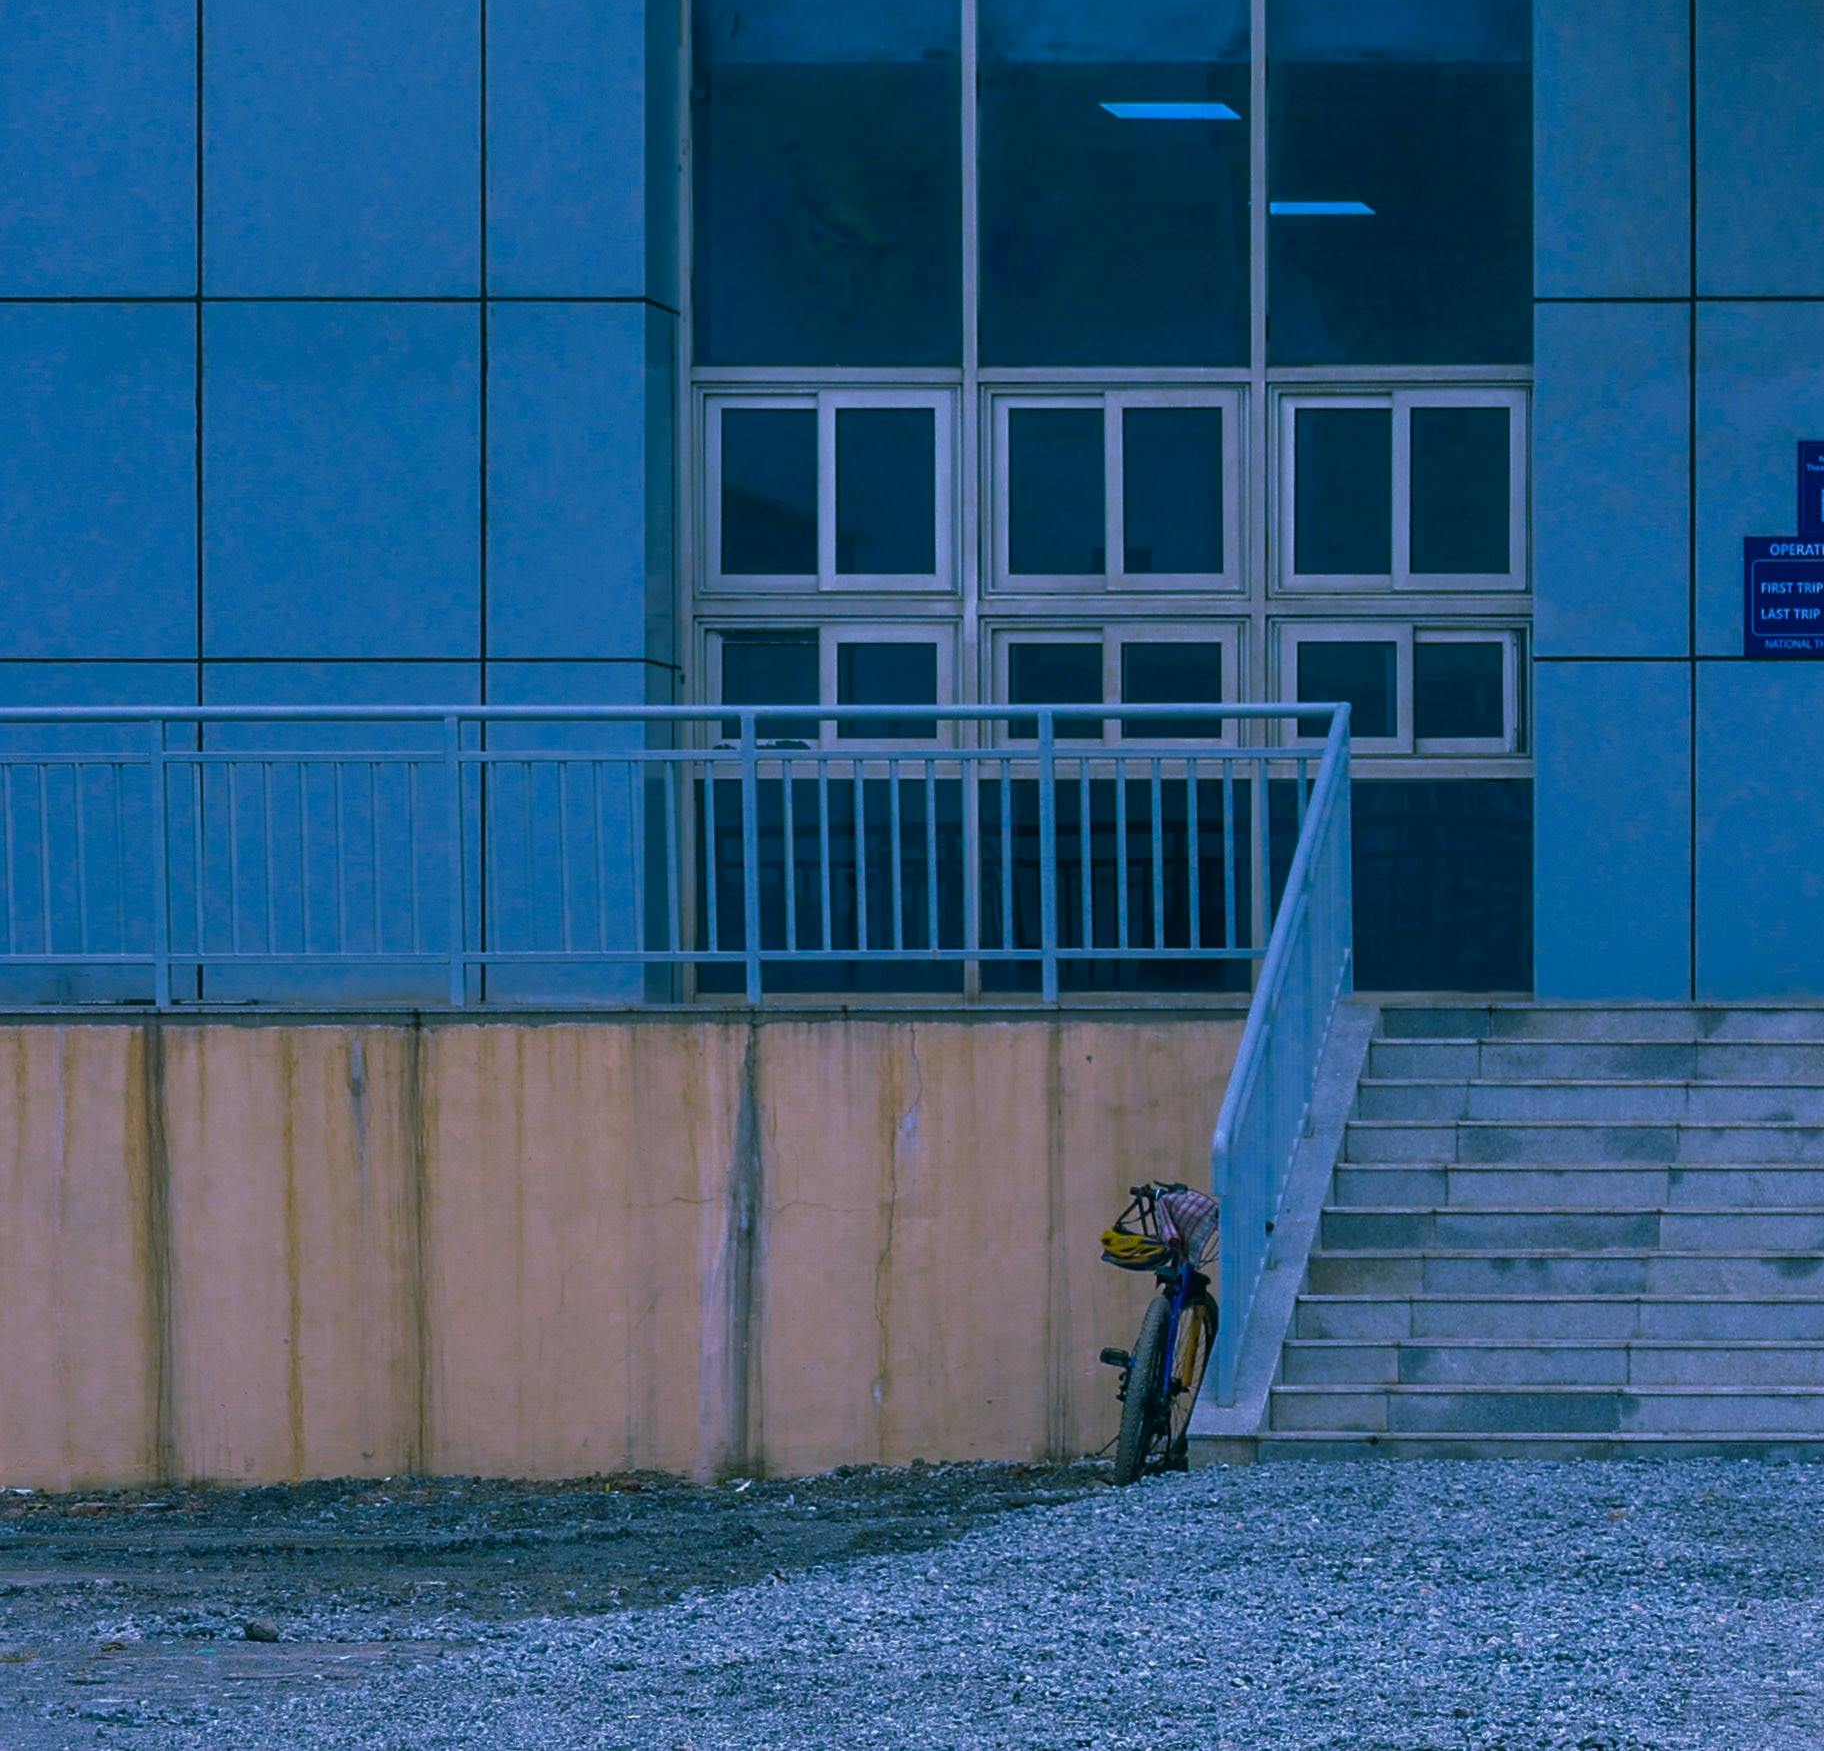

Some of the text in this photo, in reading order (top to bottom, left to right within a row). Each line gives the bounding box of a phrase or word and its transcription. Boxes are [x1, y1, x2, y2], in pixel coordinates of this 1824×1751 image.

[1761, 583, 1824, 593] FIRST TRIP
[1761, 609, 1821, 619] LAST TRIP
[1765, 639, 1812, 649] NATIONAL
